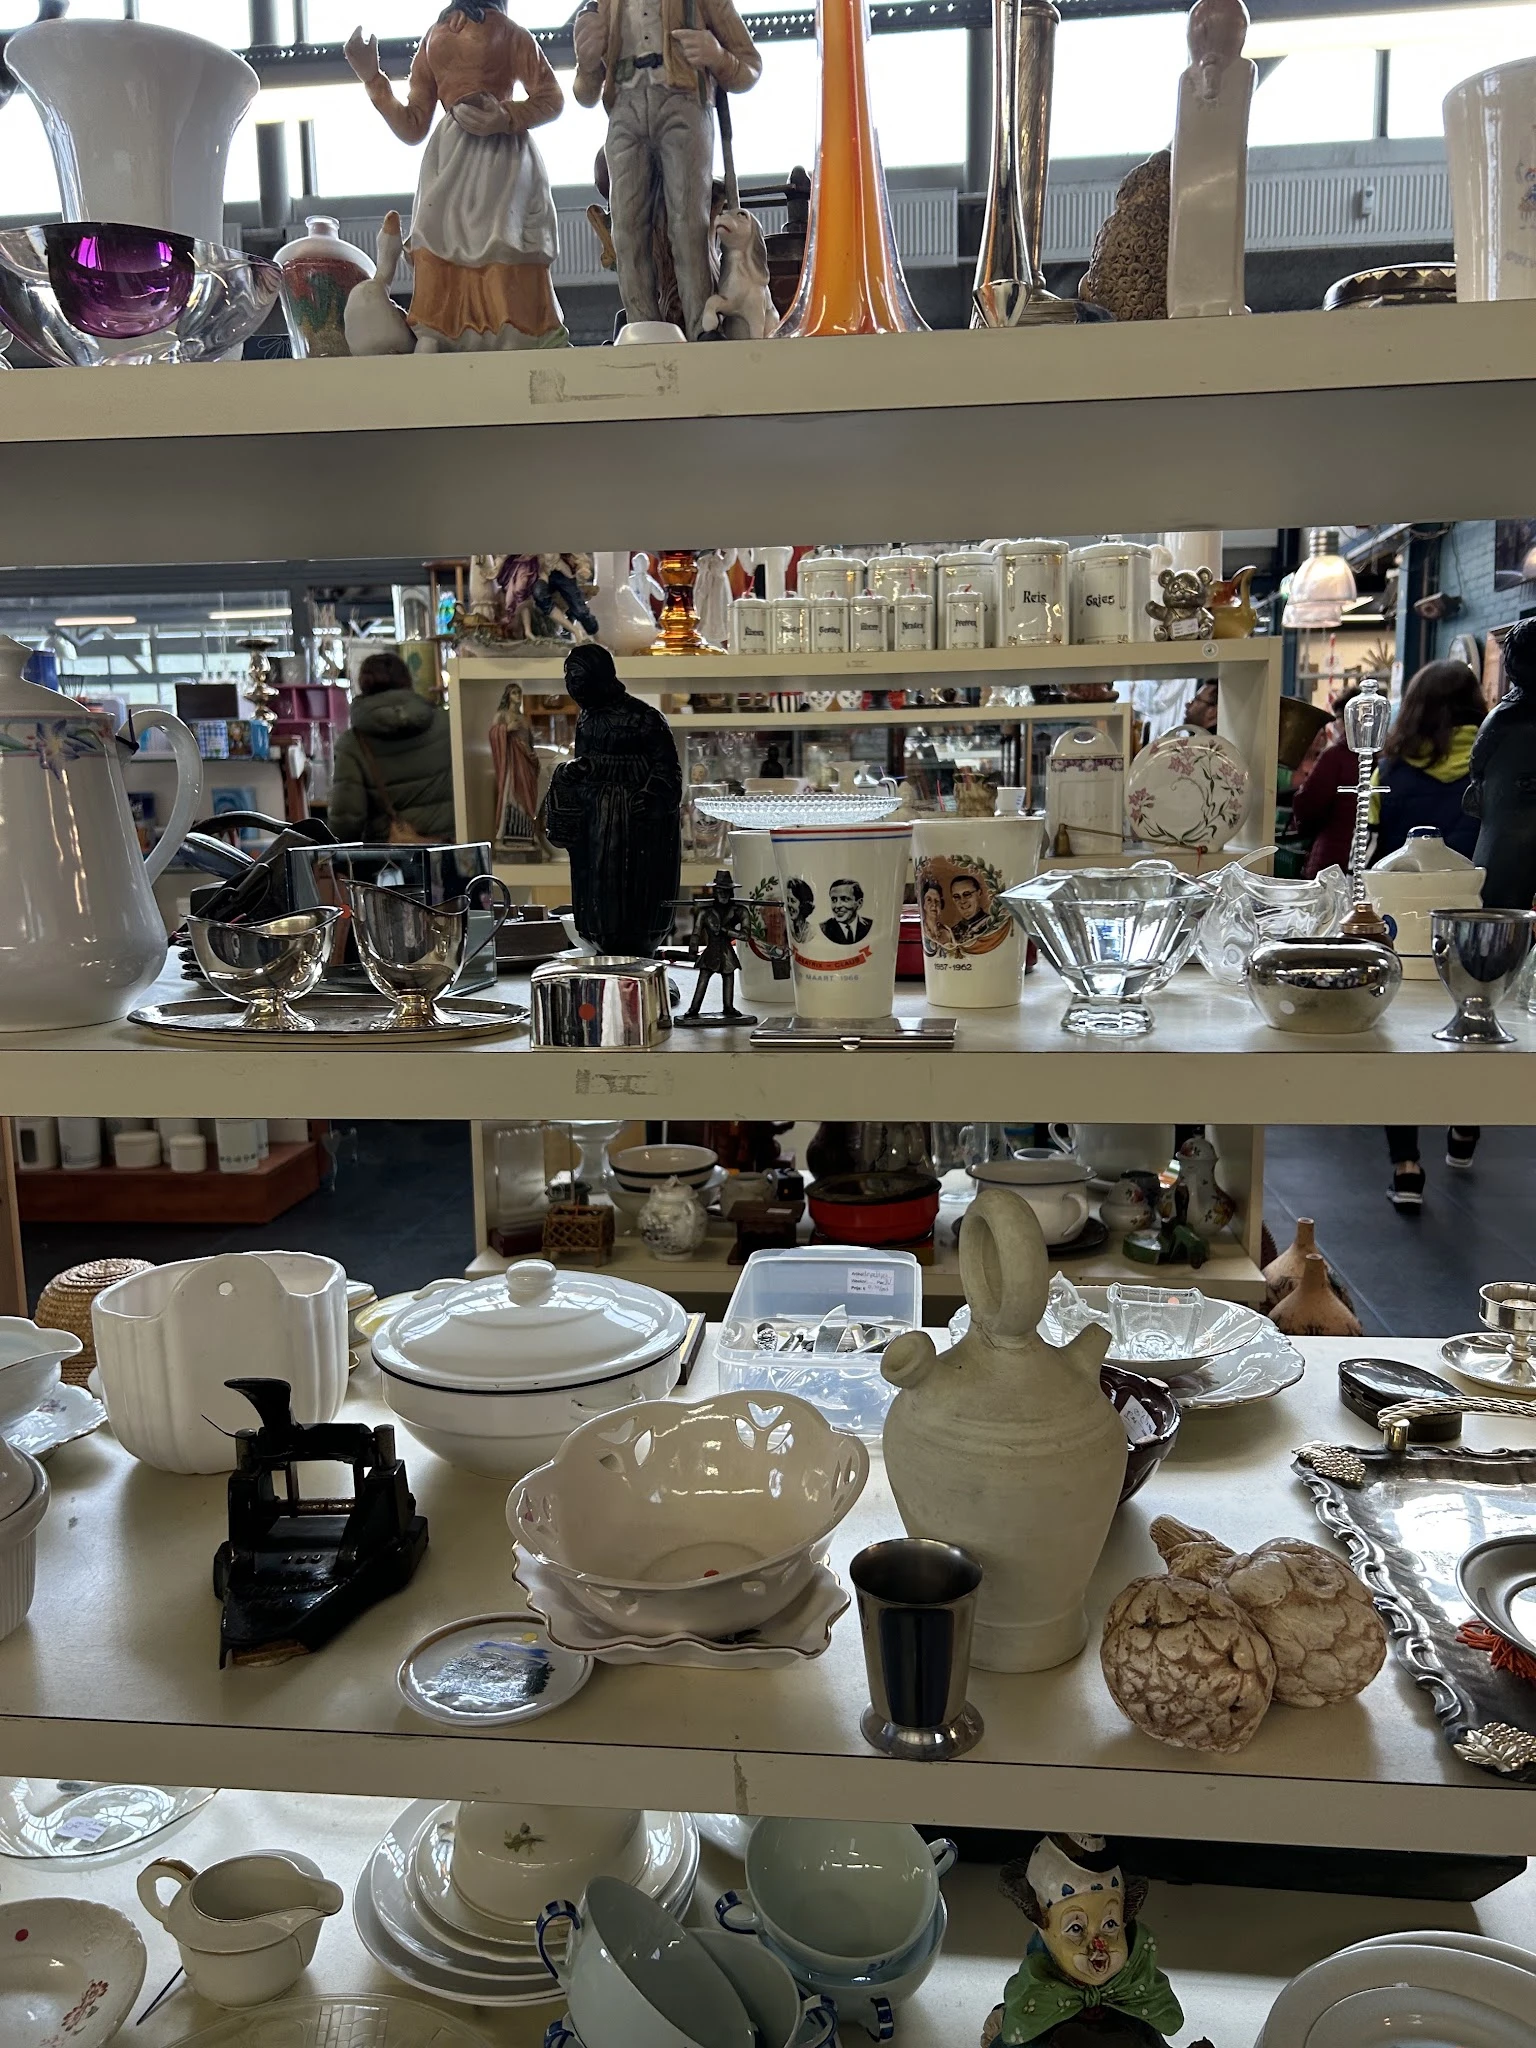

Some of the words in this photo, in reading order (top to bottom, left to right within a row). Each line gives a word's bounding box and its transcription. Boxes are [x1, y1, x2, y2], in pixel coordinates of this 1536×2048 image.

[1023, 590, 1048, 605] Reis
[1086, 594, 1115, 609] Gries
[834, 957, 861, 968] CLAUS
